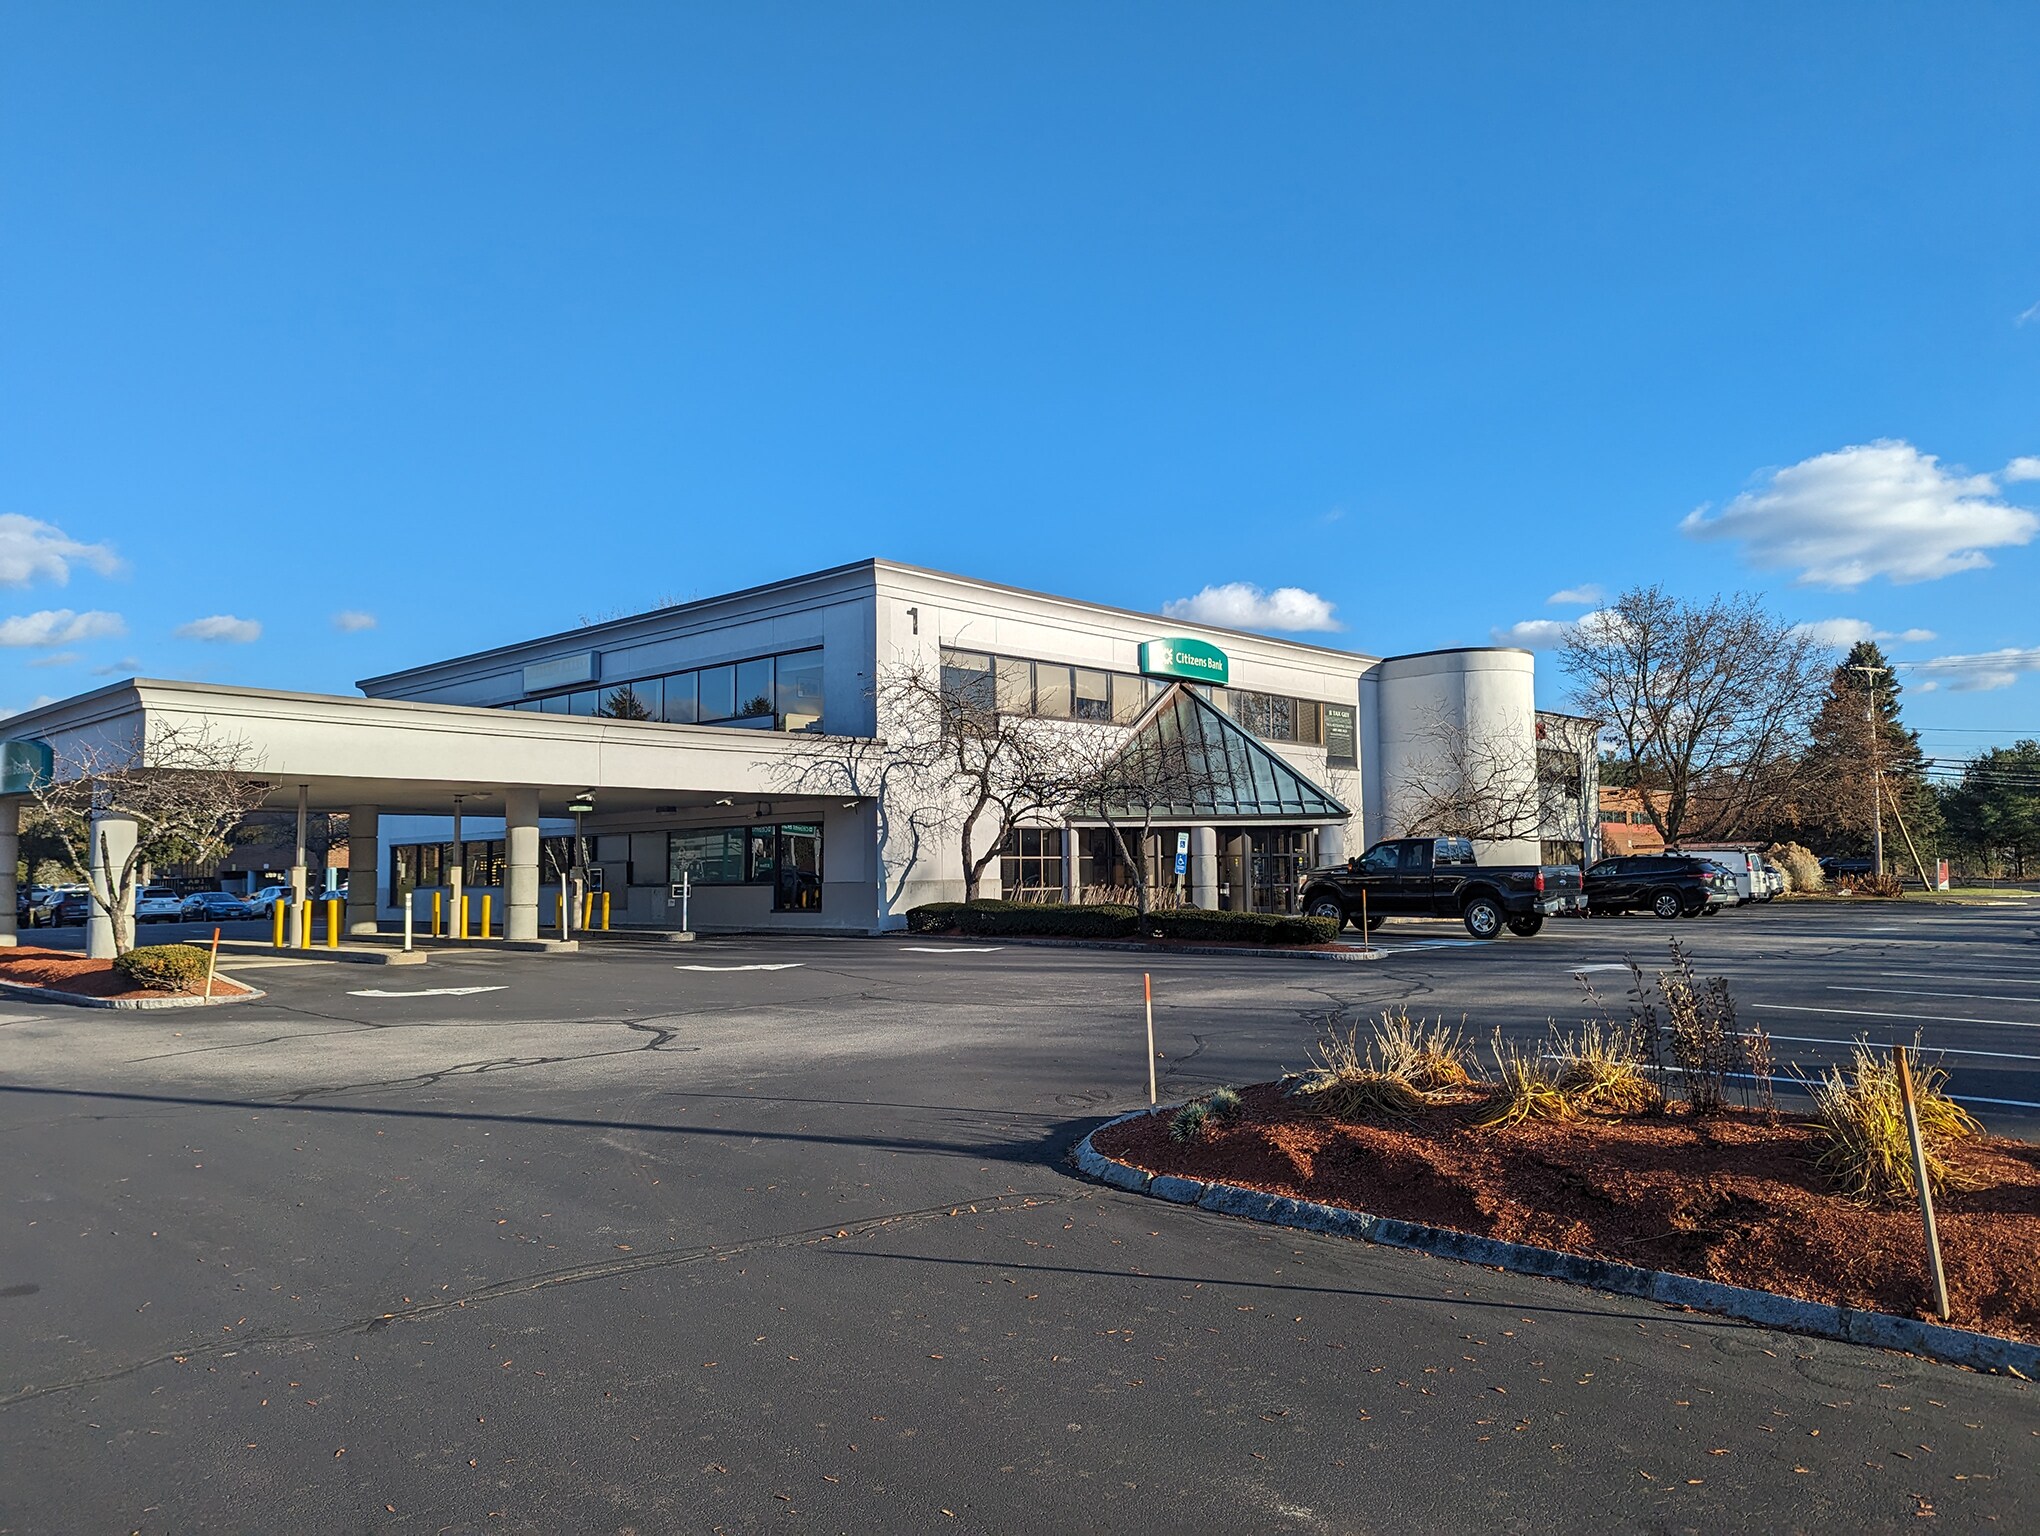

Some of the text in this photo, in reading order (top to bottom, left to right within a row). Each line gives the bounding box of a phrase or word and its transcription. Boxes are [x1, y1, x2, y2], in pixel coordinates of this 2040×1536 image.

[907, 607, 918, 635] 1
[1175, 652, 1223, 671] Citizens Bank
